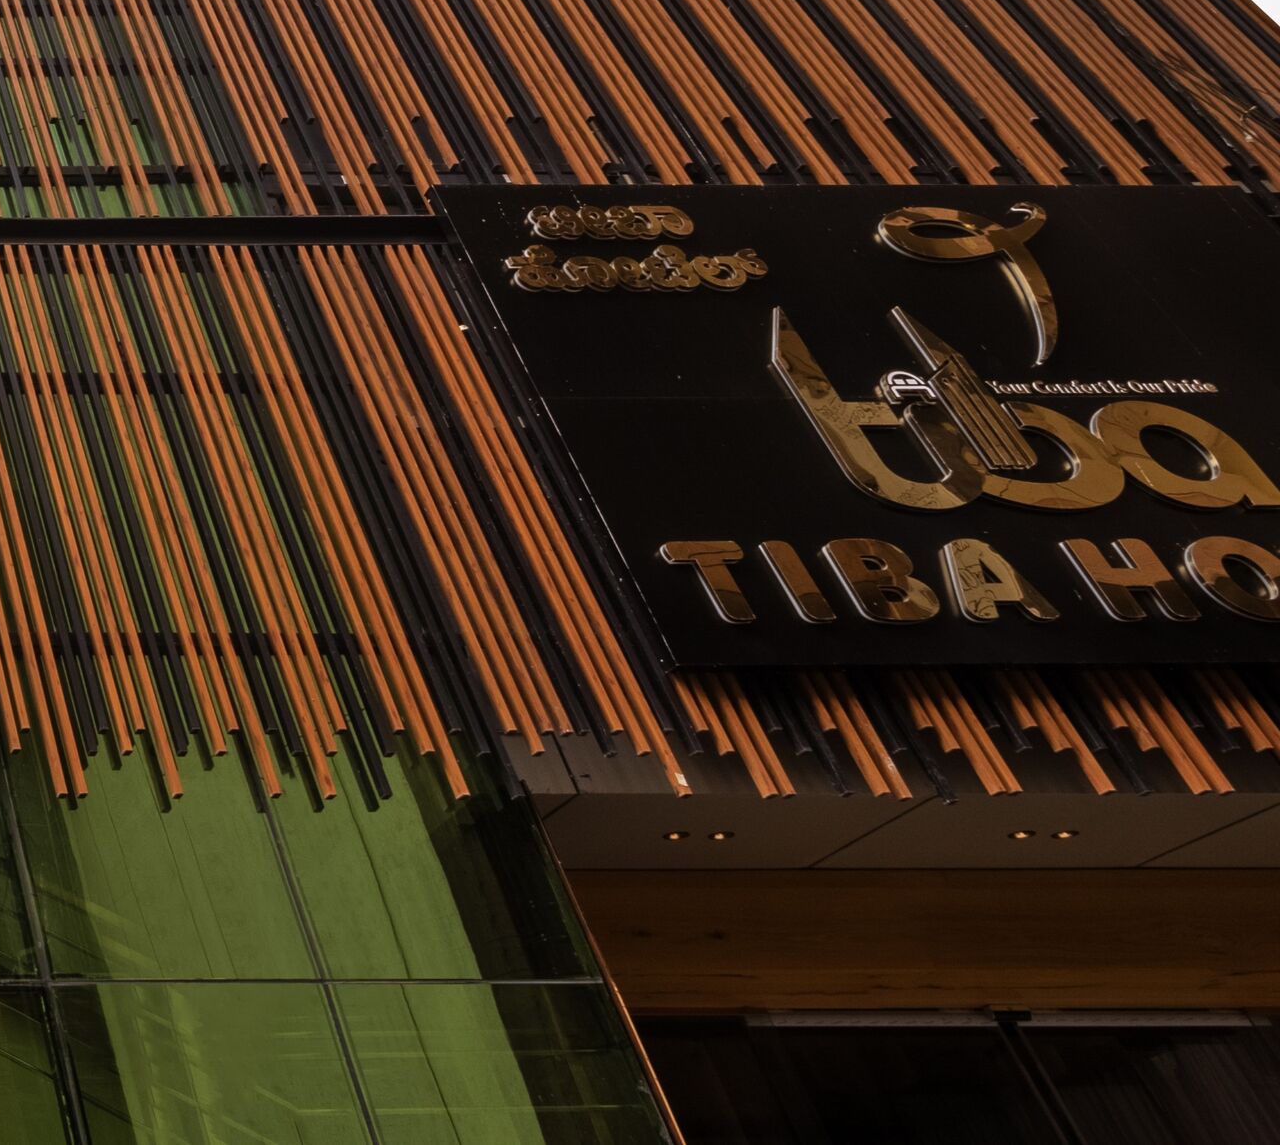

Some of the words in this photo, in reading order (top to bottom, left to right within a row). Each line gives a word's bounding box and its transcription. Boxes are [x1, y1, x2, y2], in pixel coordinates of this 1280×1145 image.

[525, 205, 696, 241] ಟೀಬಾ
[770, 305, 1280, 512] tiba
[985, 379, 1032, 395] Your
[1032, 379, 1108, 395] Comfort
[1109, 379, 1128, 394] Is
[1128, 379, 1164, 394] Our
[1164, 378, 1219, 394] Pride
[659, 538, 1060, 625] TIBA
